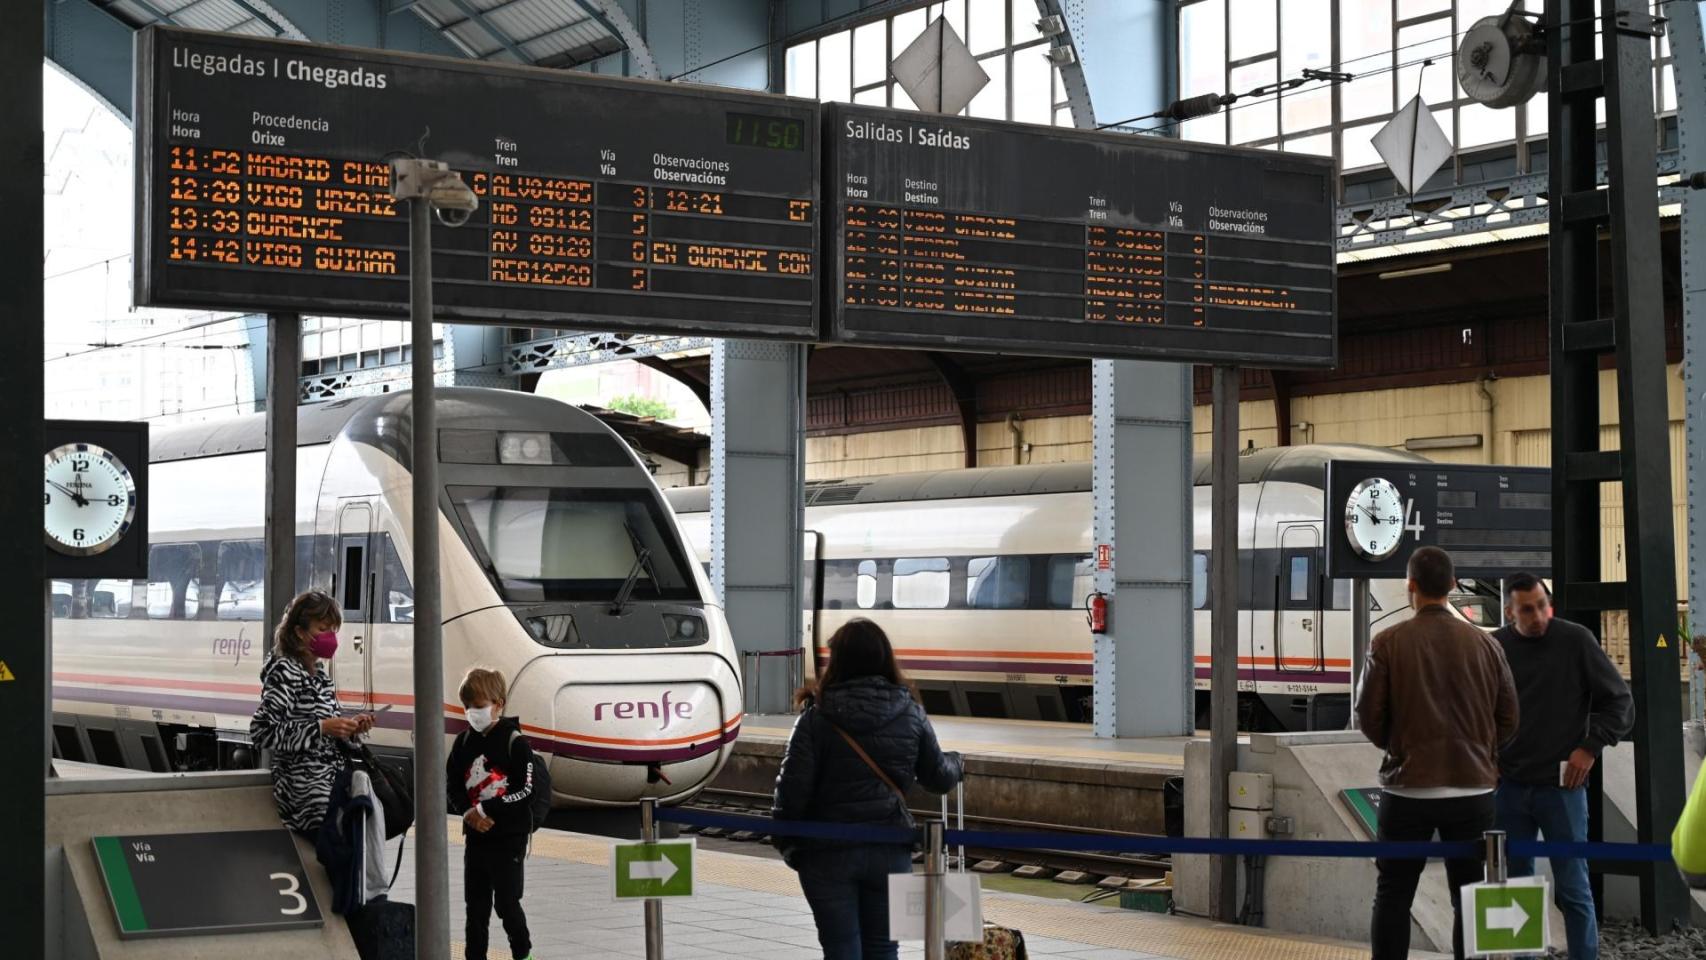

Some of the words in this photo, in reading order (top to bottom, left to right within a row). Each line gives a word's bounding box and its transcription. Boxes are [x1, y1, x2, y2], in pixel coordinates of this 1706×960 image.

[173, 48, 265, 76] Llegadas
[286, 60, 387, 88] Chegadas
[172, 109, 200, 123] Hora
[252, 111, 329, 132] Procedencia
[495, 139, 517, 151] Tren
[601, 149, 616, 161] Vía
[653, 153, 730, 172] Observaciones
[172, 125, 200, 138] Hora
[252, 130, 285, 146] Orixe
[495, 154, 518, 167] Tren
[601, 164, 616, 176] Vía
[653, 168, 726, 185] Observacións
[846, 120, 903, 143] Salidas
[918, 128, 970, 150] Saídas
[170, 147, 241, 175] 11:52
[247, 153, 330, 182] MADRID
[667, 191, 724, 214] 12:21
[247, 183, 302, 209] VIGO
[847, 173, 868, 185] Hora
[905, 178, 937, 191] Destino
[1089, 196, 1106, 207] Tren
[1169, 201, 1183, 213] Vía
[1209, 206, 1268, 221] Observaciones
[847, 187, 868, 198] Hora
[905, 192, 939, 204] Destino
[1089, 209, 1107, 220] Tren
[1169, 215, 1183, 227] Vía
[1209, 221, 1265, 234] Observacións
[170, 207, 241, 233] 13:33
[247, 212, 344, 241] OURENSE
[492, 232, 517, 253] AV
[688, 246, 768, 272] OURENSE
[170, 236, 241, 263] 14:42
[246, 242, 302, 268] VIGO
[71, 460, 89, 473] 12
[108, 495, 119, 506] 3
[1369, 489, 1380, 499] 12
[73, 528, 85, 541] 6
[1404, 498, 1425, 541] 4
[1370, 541, 1377, 550] 6
[213, 626, 251, 667] renfe
[594, 690, 693, 731] renfe
[132, 841, 151, 851] Vía
[136, 852, 156, 863] Vía
[269, 872, 308, 916] 3
